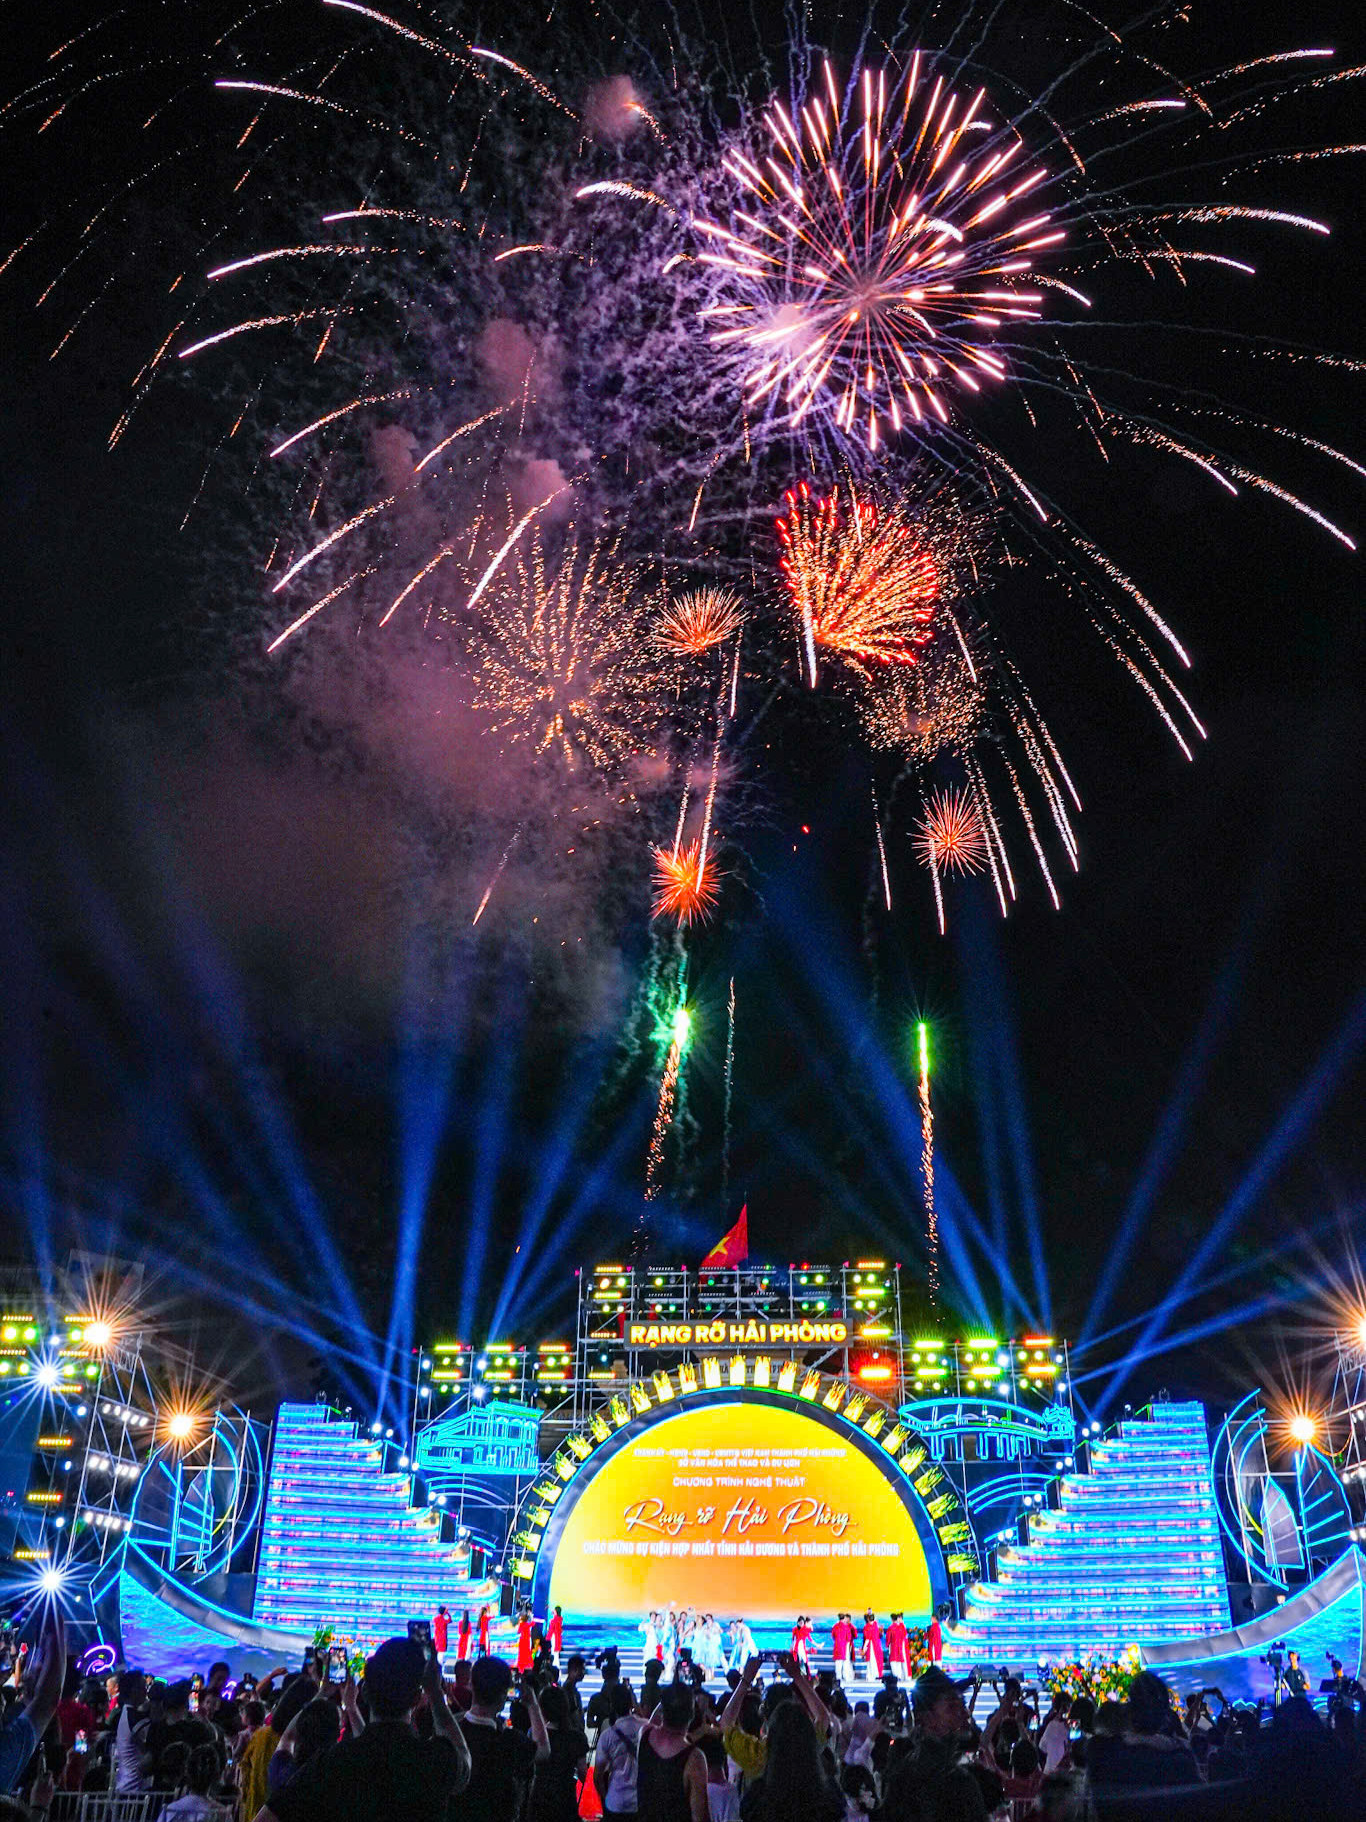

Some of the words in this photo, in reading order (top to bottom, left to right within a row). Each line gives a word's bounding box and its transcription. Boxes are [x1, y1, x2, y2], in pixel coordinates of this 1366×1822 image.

[631, 1325, 692, 1348] RẠNG
[695, 1320, 727, 1343] RỠ
[730, 1319, 766, 1342] HẢI
[770, 1319, 847, 1343] PHÒNG
[739, 1458, 759, 1467] THAO
[760, 1456, 770, 1467] VÀ
[772, 1458, 782, 1467] DU
[673, 1476, 713, 1487] CHƯƠNG
[715, 1474, 743, 1487] TRÌNH
[746, 1475, 772, 1488] NGHỆ
[775, 1474, 806, 1488] THUẬT
[624, 1497, 694, 1536] Rạng
[696, 1506, 717, 1525] rỡ
[722, 1497, 768, 1534] Hải
[777, 1497, 859, 1537] Phòng
[650, 1540, 672, 1557] KIỆN
[672, 1541, 690, 1557] HỢP
[692, 1540, 715, 1556] NHẤT
[738, 1540, 754, 1556] HẢI
[755, 1542, 786, 1556] DƯƠNG
[787, 1541, 800, 1556] VÀ
[801, 1541, 830, 1556] THÀNH
[831, 1541, 850, 1557] PHỐ
[851, 1540, 867, 1556] HẢI
[868, 1541, 900, 1556] PHÒNG
